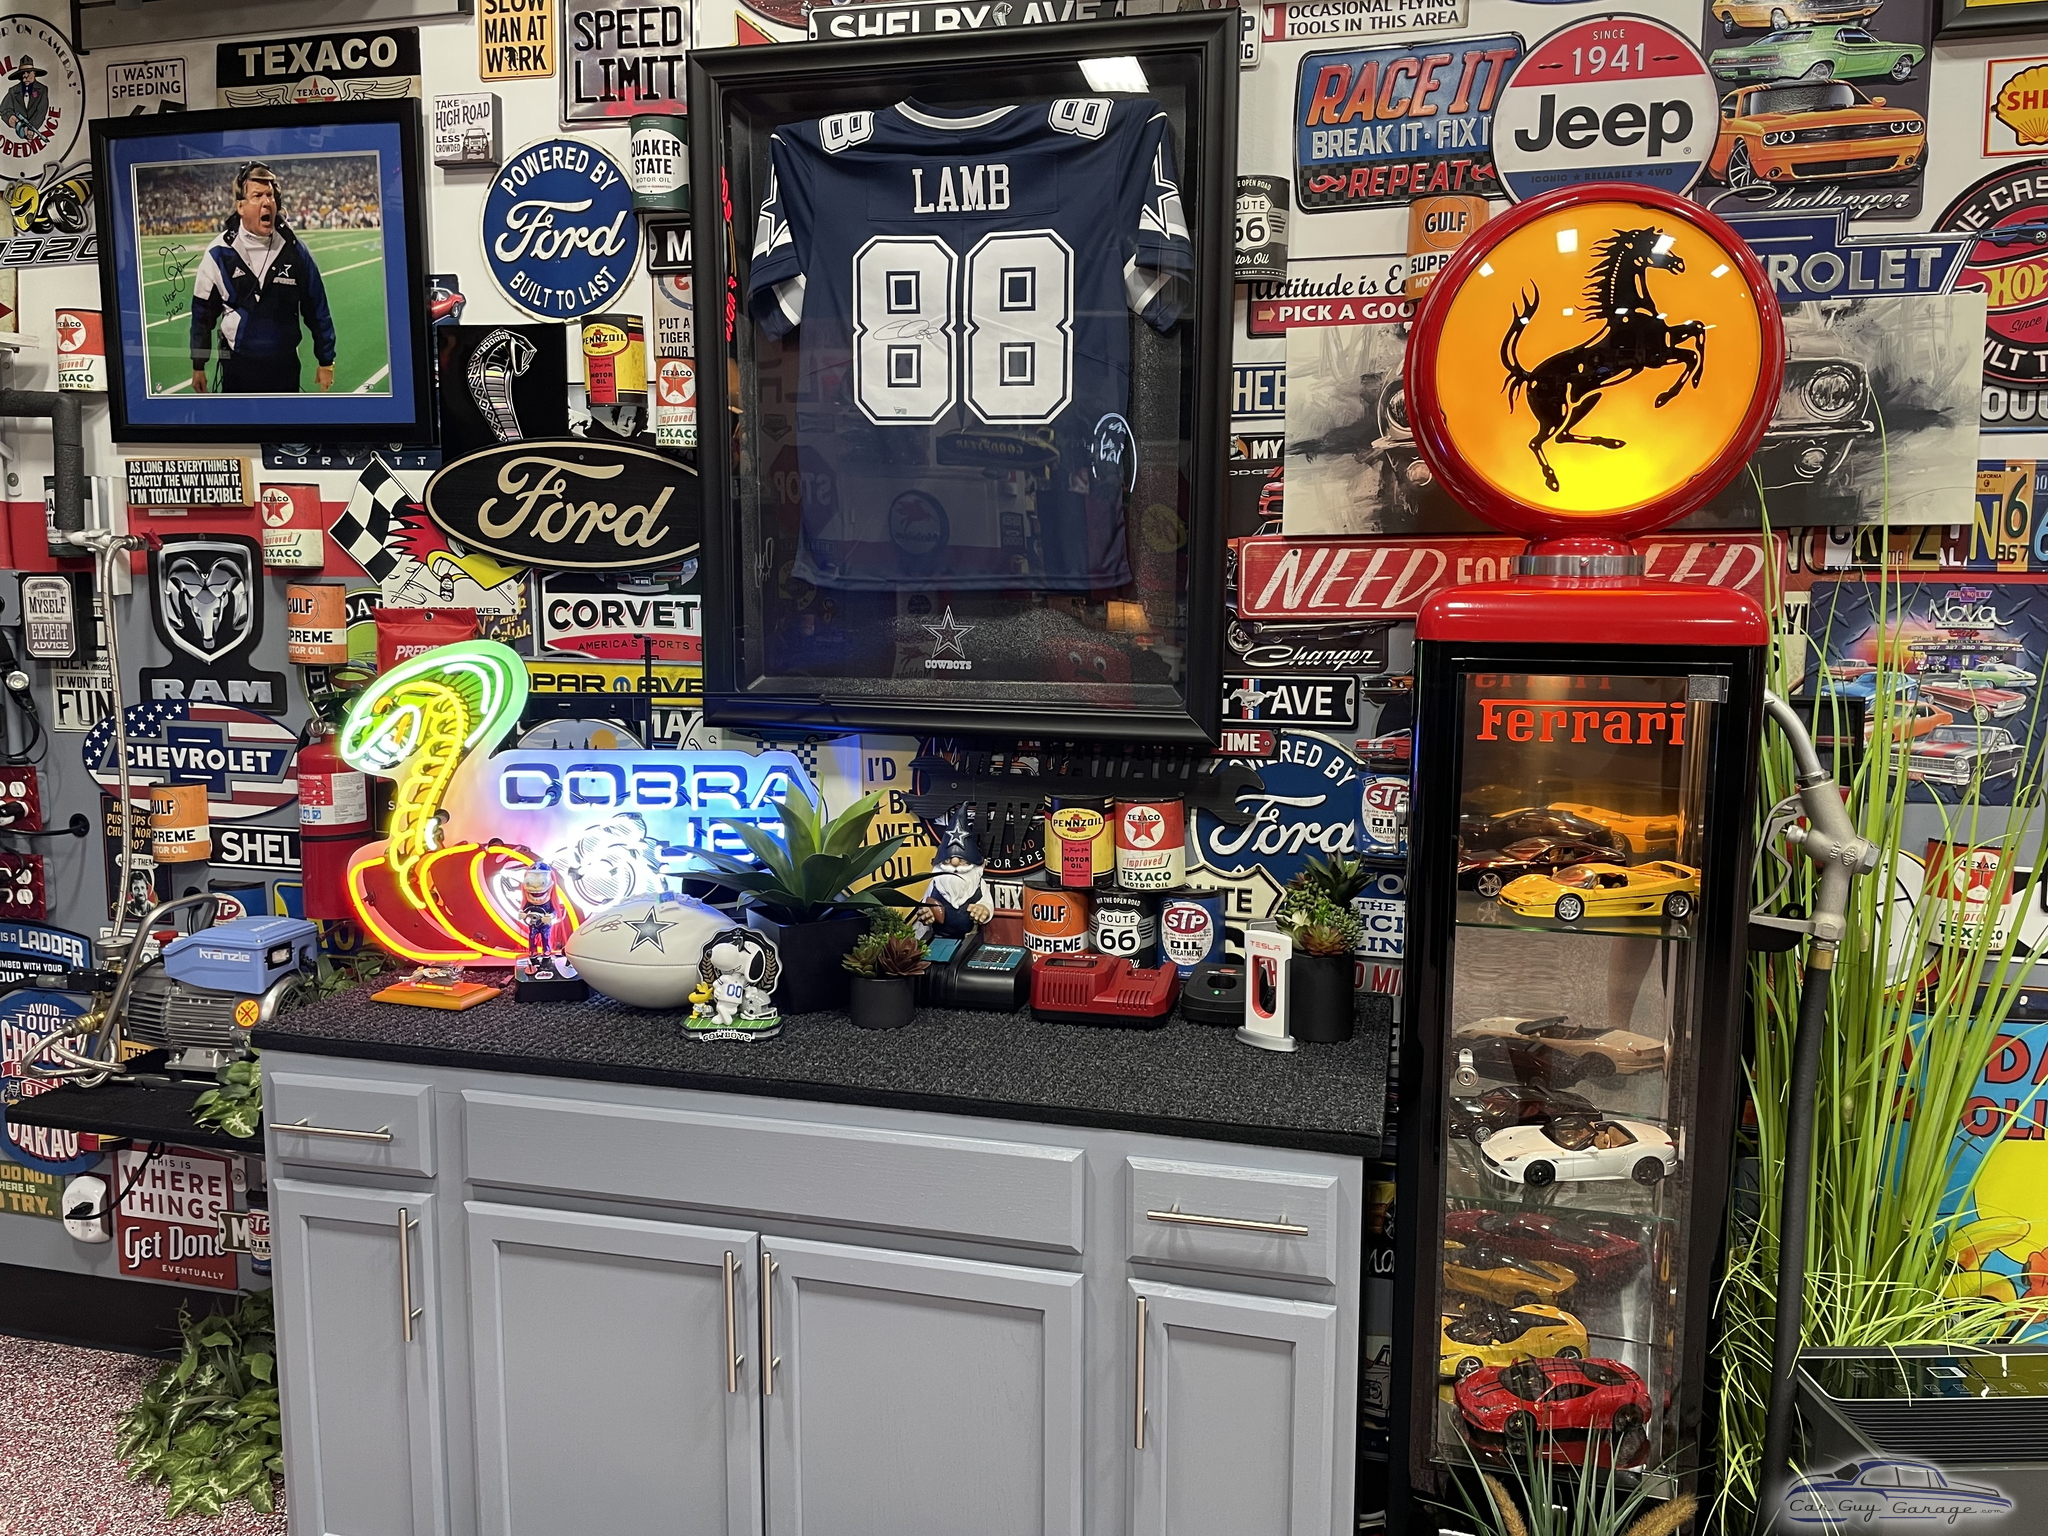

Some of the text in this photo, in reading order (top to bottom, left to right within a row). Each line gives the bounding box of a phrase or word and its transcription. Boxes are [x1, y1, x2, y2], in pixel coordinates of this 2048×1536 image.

[485, 15, 547, 44] MAN AT
[573, 6, 682, 51] SPEED
[1288, 20, 1340, 35] TOOLS
[1344, 18, 1362, 32] IN
[1369, 15, 1407, 30] THIS
[1412, 10, 1459, 26] AREA
[1592, 28, 1626, 41] SINCE
[238, 36, 398, 77] TEXACO
[1572, 43, 1646, 76] 1941
[124, 64, 178, 81] WASN'T
[575, 55, 684, 104] LIMIT
[112, 79, 182, 99] SPEEDING
[296, 86, 336, 98] TEXACO
[1306, 47, 1519, 126] RACE IT
[435, 99, 460, 110] TAKE
[435, 101, 491, 132] HIGH ROAD
[1515, 94, 1693, 157] Jeep
[435, 135, 461, 144] LESS
[1311, 120, 1479, 160] BREAK IT FIX
[501, 146, 621, 198] POWERED BY
[634, 157, 673, 176] STATE
[1531, 167, 1674, 185] ICONIC RELIABLE 4WD
[912, 163, 1011, 214] LAMB
[1257, 180, 1272, 191] ROAD
[1348, 159, 1473, 198] REPEAT
[1707, 184, 1912, 221] Challenger
[493, 198, 629, 264] Ford
[1424, 211, 1468, 235] GULF
[1253, 252, 1270, 265] Oil
[510, 265, 618, 311] BUILT TO LAST
[1359, 274, 1379, 296] is
[1278, 303, 1356, 323] PICK A
[659, 317, 691, 330] PUT A
[852, 229, 1074, 426] 88
[2009, 315, 2042, 334] Since
[659, 331, 691, 344] TIGER
[662, 369, 693, 377] TEXACO
[1252, 439, 1284, 460] MY
[129, 460, 239, 474] AS LONG AS EVERYTHING IS
[129, 474, 163, 488] EXACTLY
[164, 474, 180, 488] THE
[181, 474, 199, 488] WAY
[205, 473, 231, 487] WANT
[231, 473, 243, 487] IT,
[130, 488, 243, 505] I'M TOTALLY FLEXIBLE
[477, 455, 676, 548] Ford
[1254, 548, 1448, 610] NEED
[28, 597, 67, 614] MYSELF
[1928, 598, 2014, 626] Nova
[31, 623, 68, 640] EXPERT
[33, 641, 69, 649] ADVICE
[308, 646, 325, 655] OIL
[578, 639, 639, 652] AMERICA'S
[924, 658, 973, 671] COWBOYS
[1242, 645, 1383, 672] Charger
[56, 676, 99, 689] IT WON'T
[151, 679, 273, 704] RAM
[1270, 685, 1334, 716] AVE
[1476, 698, 1686, 746] Ferrari
[124, 746, 272, 773] CHEVROLET
[868, 756, 897, 782] I'D
[1324, 755, 1356, 788] BY
[500, 762, 818, 812] COBRA
[1053, 817, 1103, 827] PENNZOIL
[171, 846, 189, 854] OIL
[984, 856, 1012, 869] FOR
[1126, 854, 1164, 871] Improved
[1121, 870, 1172, 882] TEXACO
[1124, 881, 1152, 889] MOTOR
[1113, 896, 1127, 904] OPEN
[1127, 898, 1142, 907] ROAD
[1031, 903, 1067, 924] GULF
[1100, 913, 1136, 925] ROUTE
[1166, 909, 1206, 930] STP
[18, 929, 84, 968] LADDER
[1024, 931, 1082, 953] SUPREME
[1100, 929, 1136, 951] 66
[1170, 940, 1203, 950] OIL
[1170, 949, 1203, 957] TREATMENT
[22, 961, 63, 973] WITH YOUR
[726, 983, 743, 999] 00
[28, 1003, 60, 1017] AVOID
[702, 1031, 752, 1043] COWBOYS
[180, 1160, 192, 1170] IS
[25, 1185, 36, 1194] IS
[123, 1165, 223, 1198] WHERE
[12, 1195, 54, 1217] TRY.
[124, 1190, 223, 1223] THINGS
[124, 1225, 226, 1269] Get Done
[161, 1264, 225, 1281] EVENTUALLY
